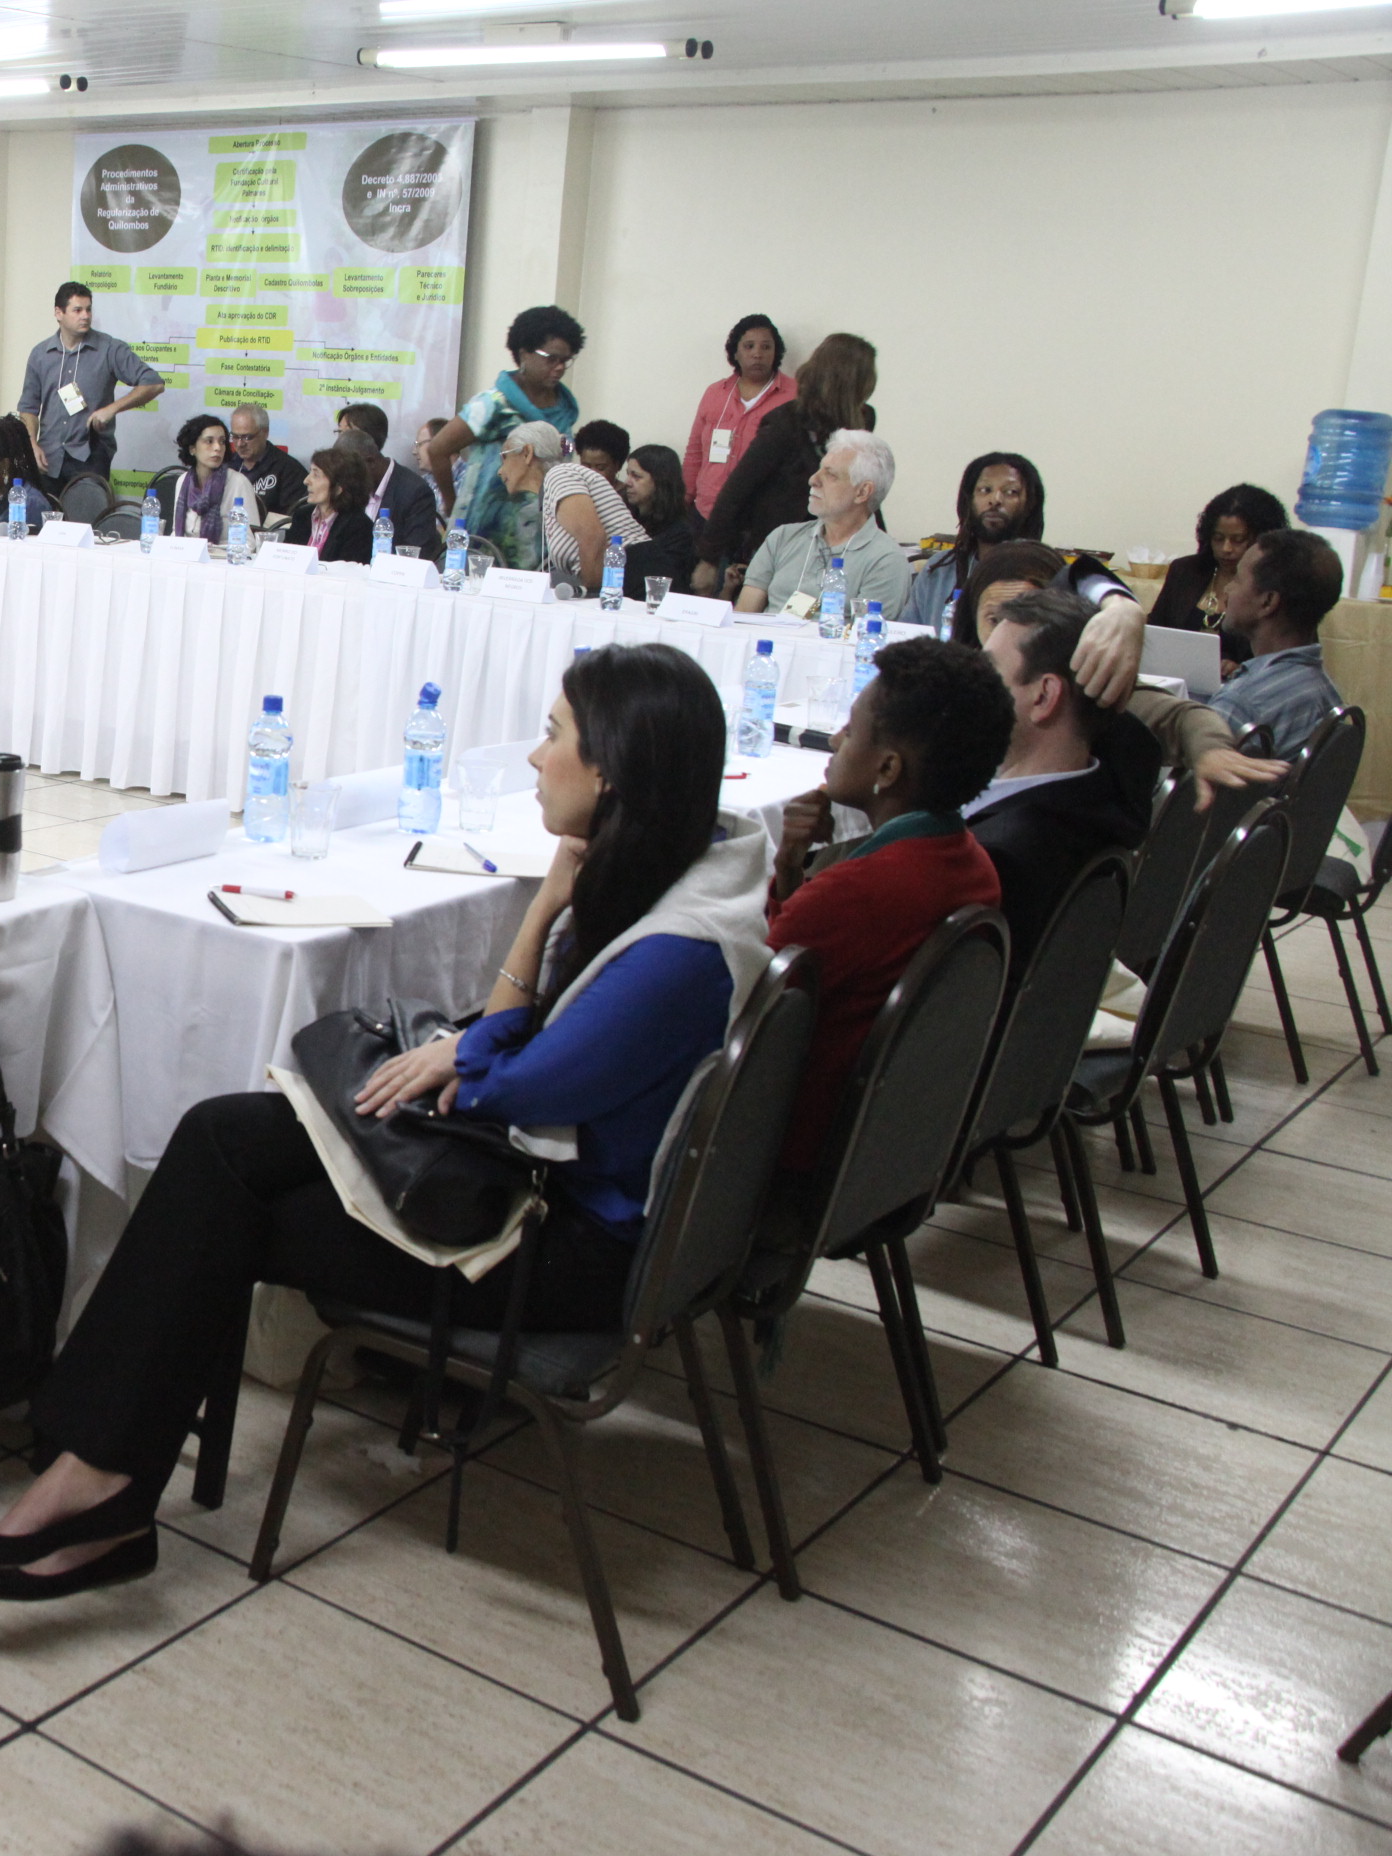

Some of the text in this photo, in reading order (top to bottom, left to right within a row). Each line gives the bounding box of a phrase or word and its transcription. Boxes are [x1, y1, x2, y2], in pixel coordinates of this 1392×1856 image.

[102, 168, 158, 178] Procedimentos
[232, 168, 263, 176] Certificação
[230, 178, 256, 186] Fundação
[361, 174, 394, 184] Decreto
[100, 182, 158, 191] Administrativos
[376, 189, 386, 198] IN
[402, 188, 435, 198] 57/2009
[125, 195, 135, 204] da
[389, 203, 410, 212] Incra
[97, 208, 159, 218] Regularização de
[261, 215, 279, 224] órgãos
[108, 220, 149, 230] Quilombos
[264, 245, 294, 253] delimitação
[86, 281, 117, 289] Antropológico
[288, 278, 323, 287] Quilombolas
[420, 281, 442, 289] Técnico
[342, 284, 384, 294] Sobreposições
[228, 312, 256, 320] aprovação
[220, 335, 248, 344] Publicação
[146, 345, 172, 353] Ocupantes
[313, 352, 343, 360] Notificação
[344, 352, 364, 362] Órgãos
[370, 354, 398, 362] Entidades
[236, 364, 270, 372] Contestatória
[326, 384, 384, 395] Instância-Julgamento
